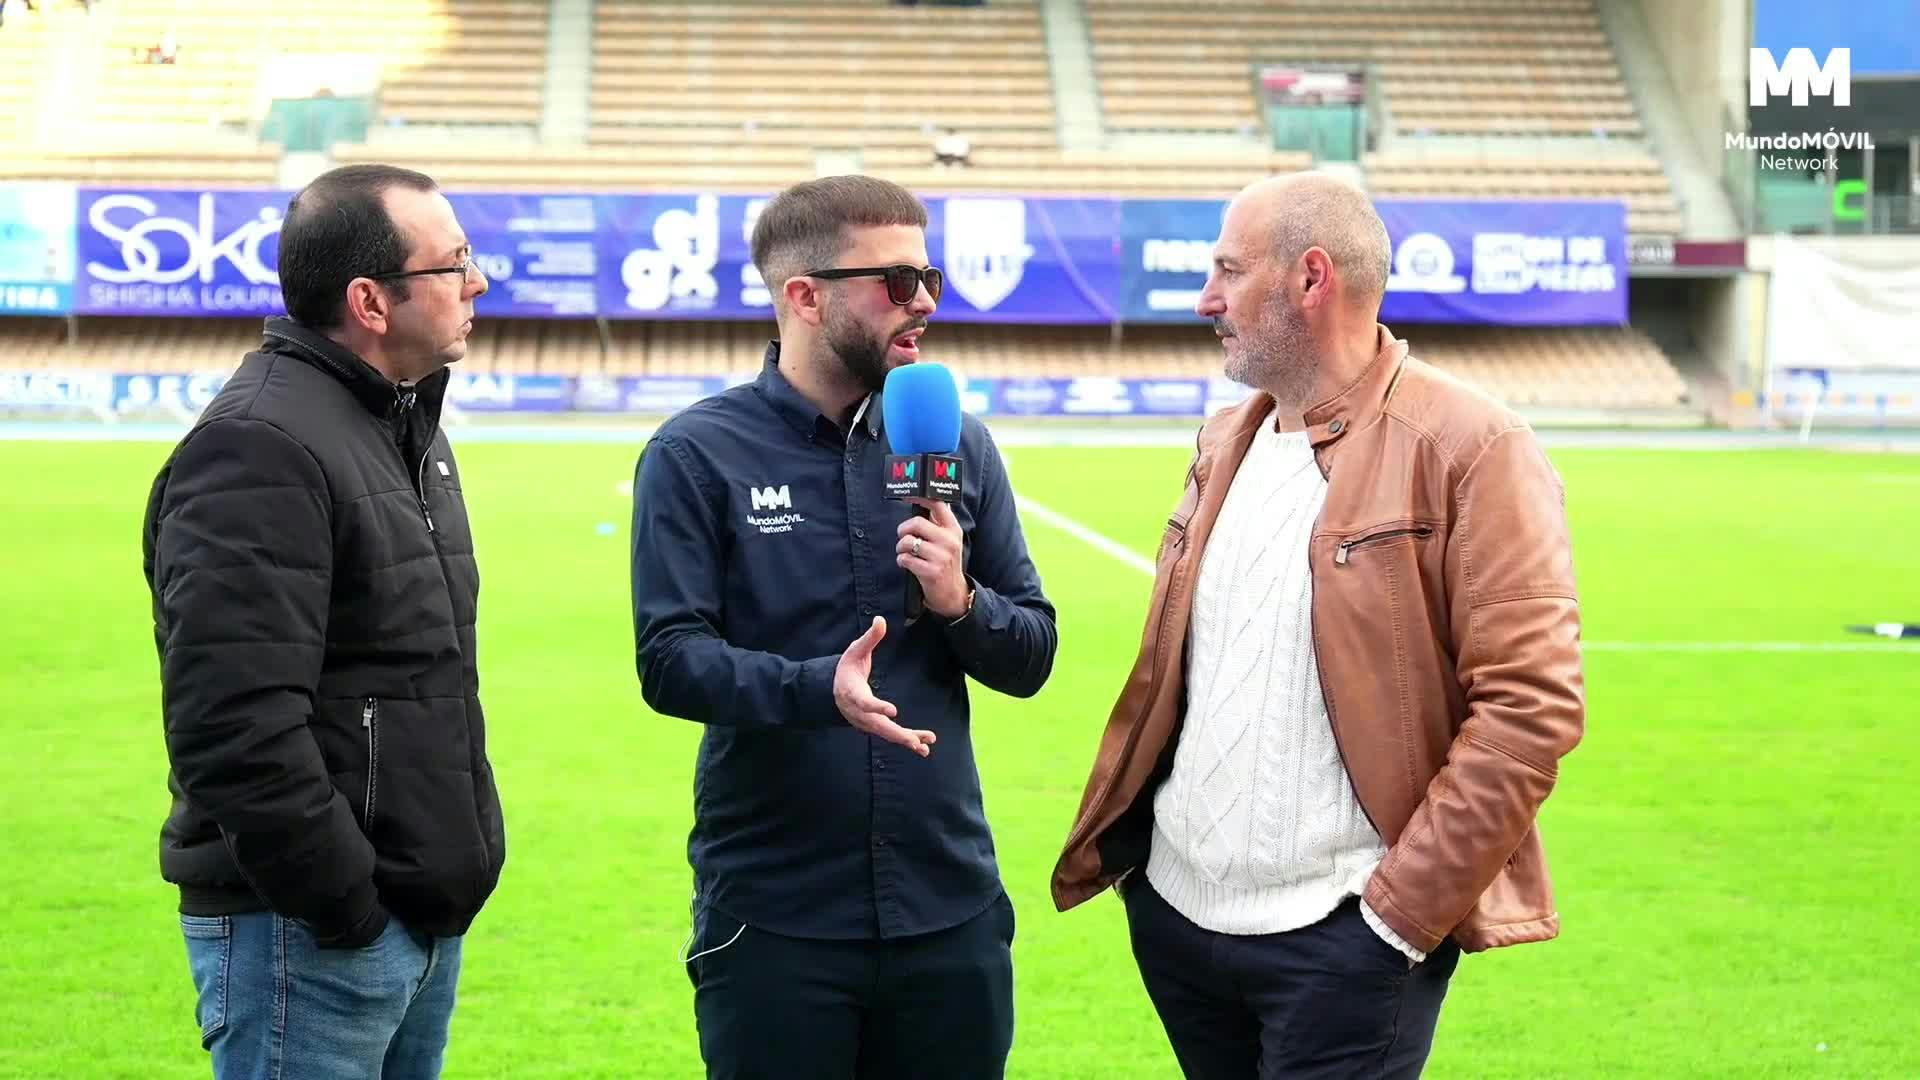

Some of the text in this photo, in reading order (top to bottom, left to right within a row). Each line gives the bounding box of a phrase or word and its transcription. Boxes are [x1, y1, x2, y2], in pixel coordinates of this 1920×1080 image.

[89, 284, 284, 310] SHISHA LOUN
[750, 484, 792, 510] MM
[746, 513, 806, 526] MundoMÓVIL
[760, 524, 793, 534] Network
